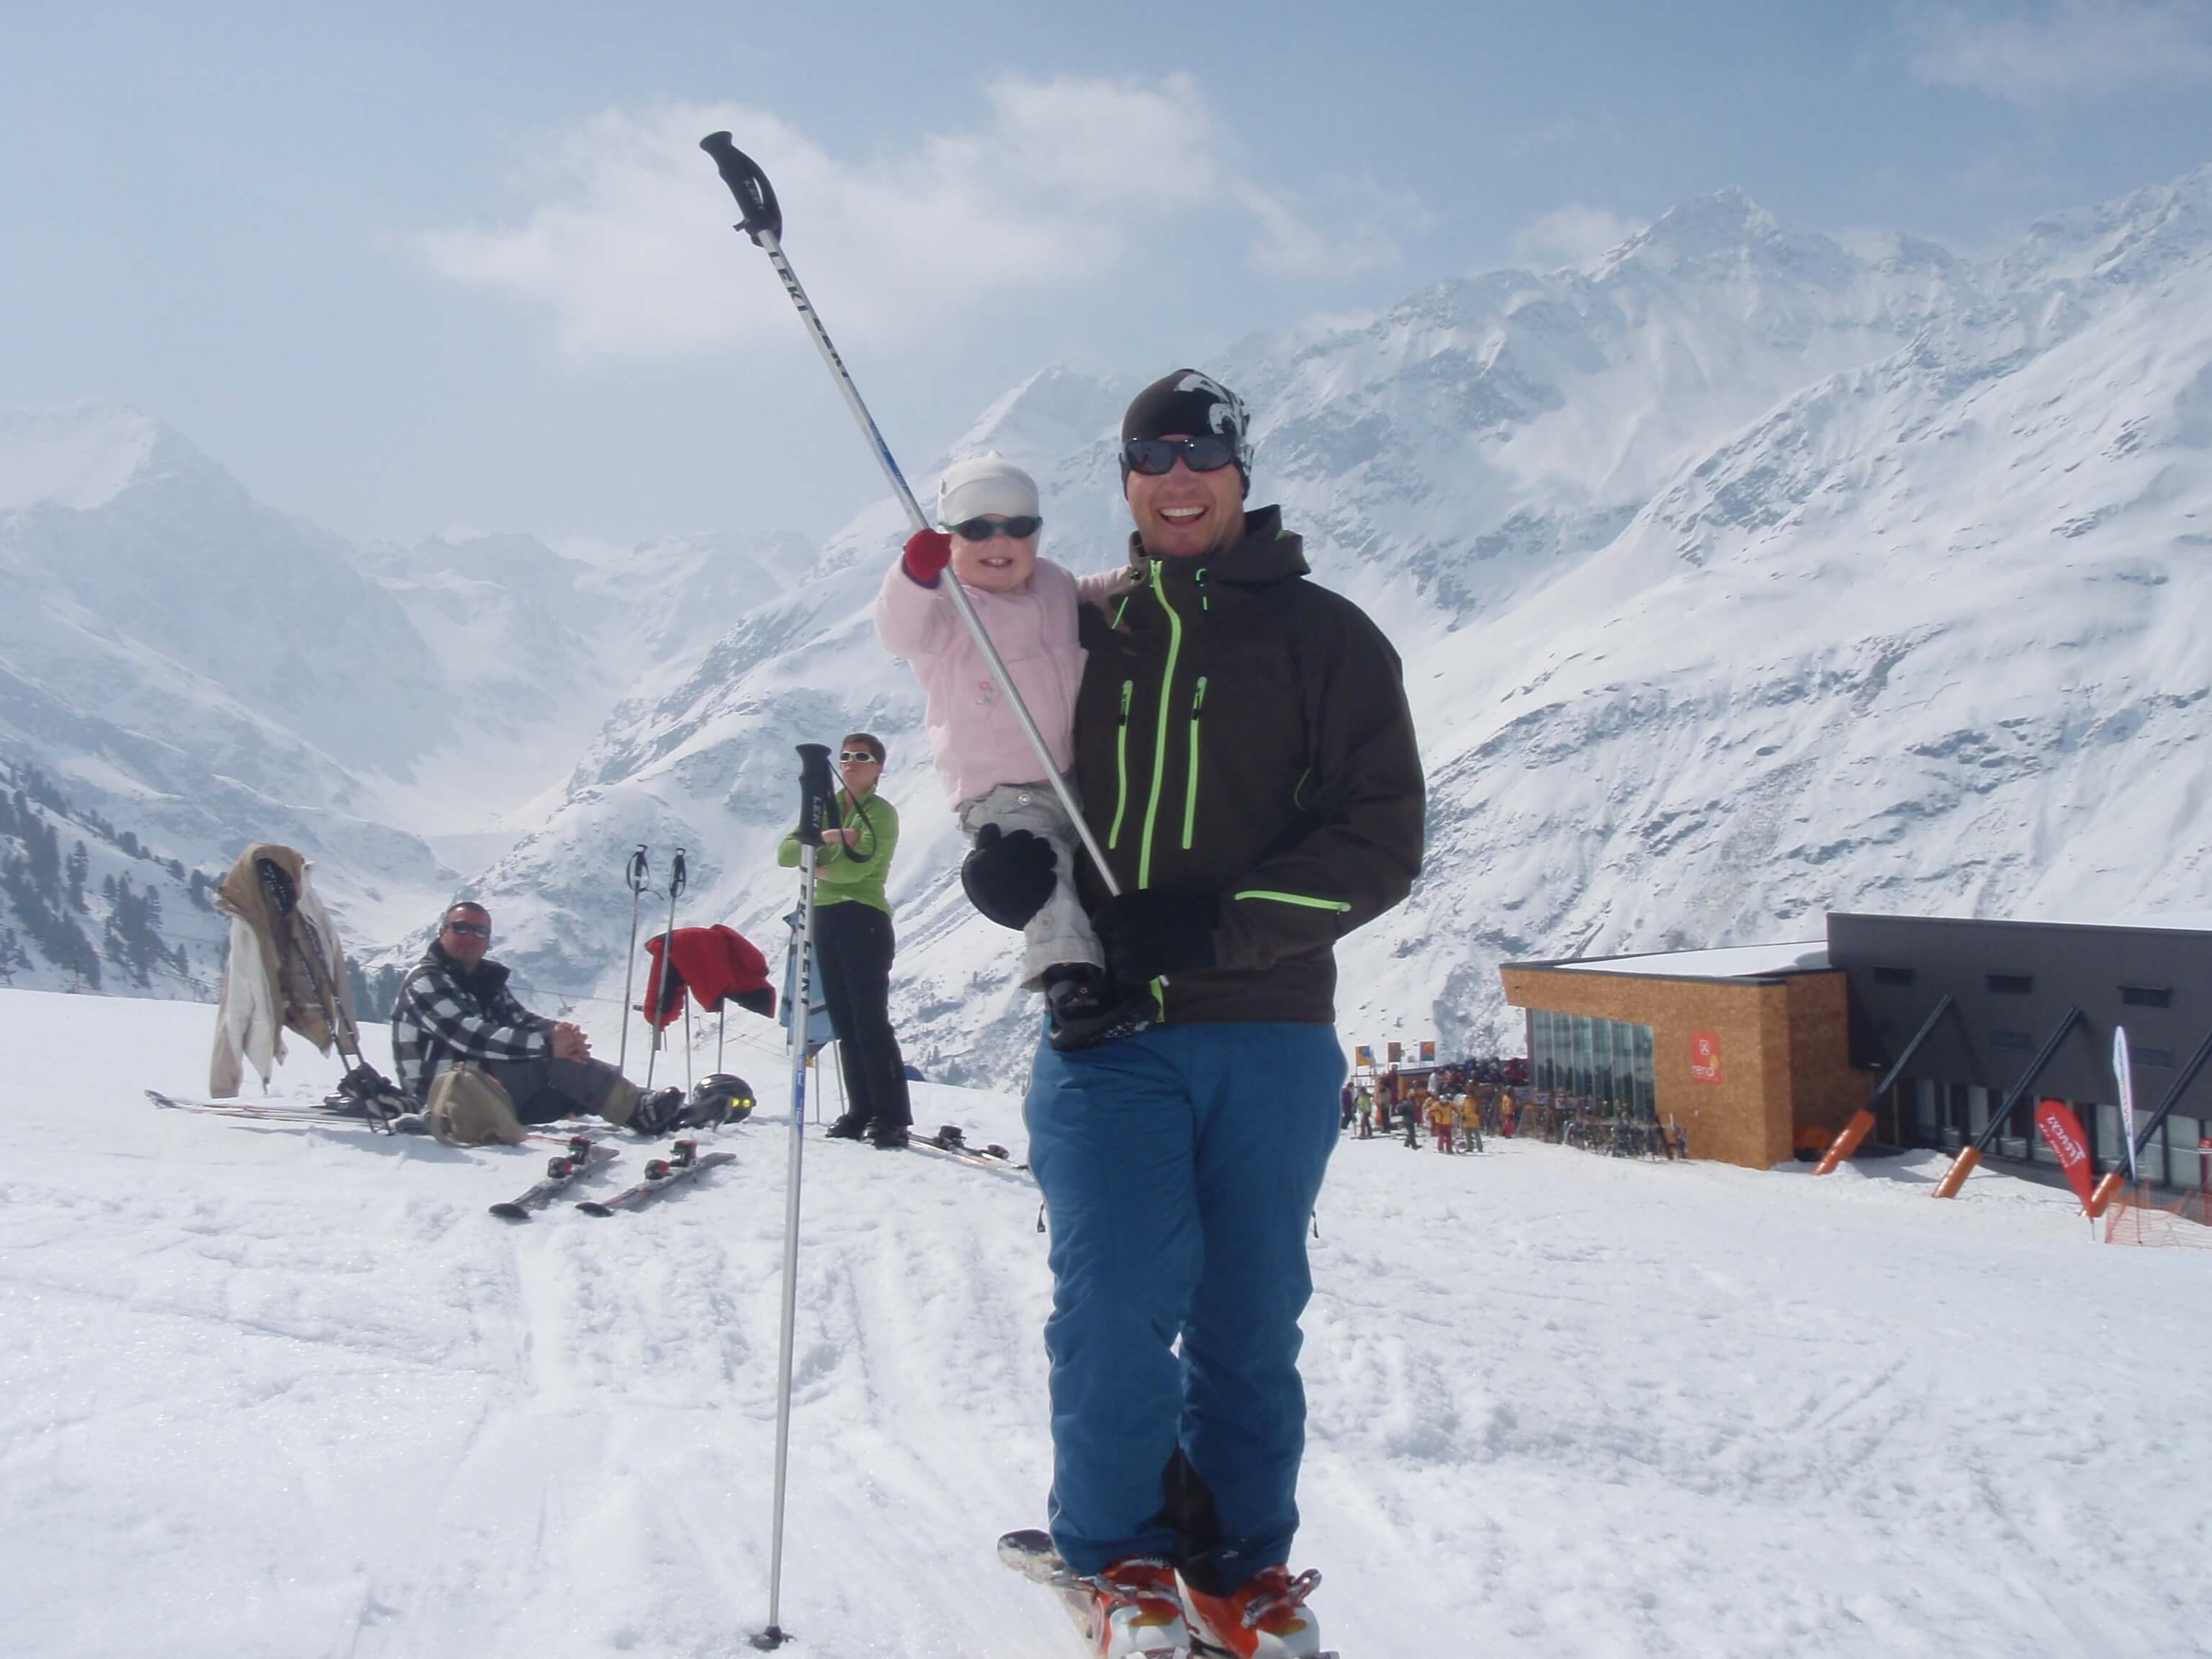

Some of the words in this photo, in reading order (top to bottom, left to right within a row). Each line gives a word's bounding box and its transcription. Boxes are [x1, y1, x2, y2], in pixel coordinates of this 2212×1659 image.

[768, 252, 809, 312] LEKI
[812, 795, 822, 829] LEKI
[800, 940, 812, 1005] LEKI
